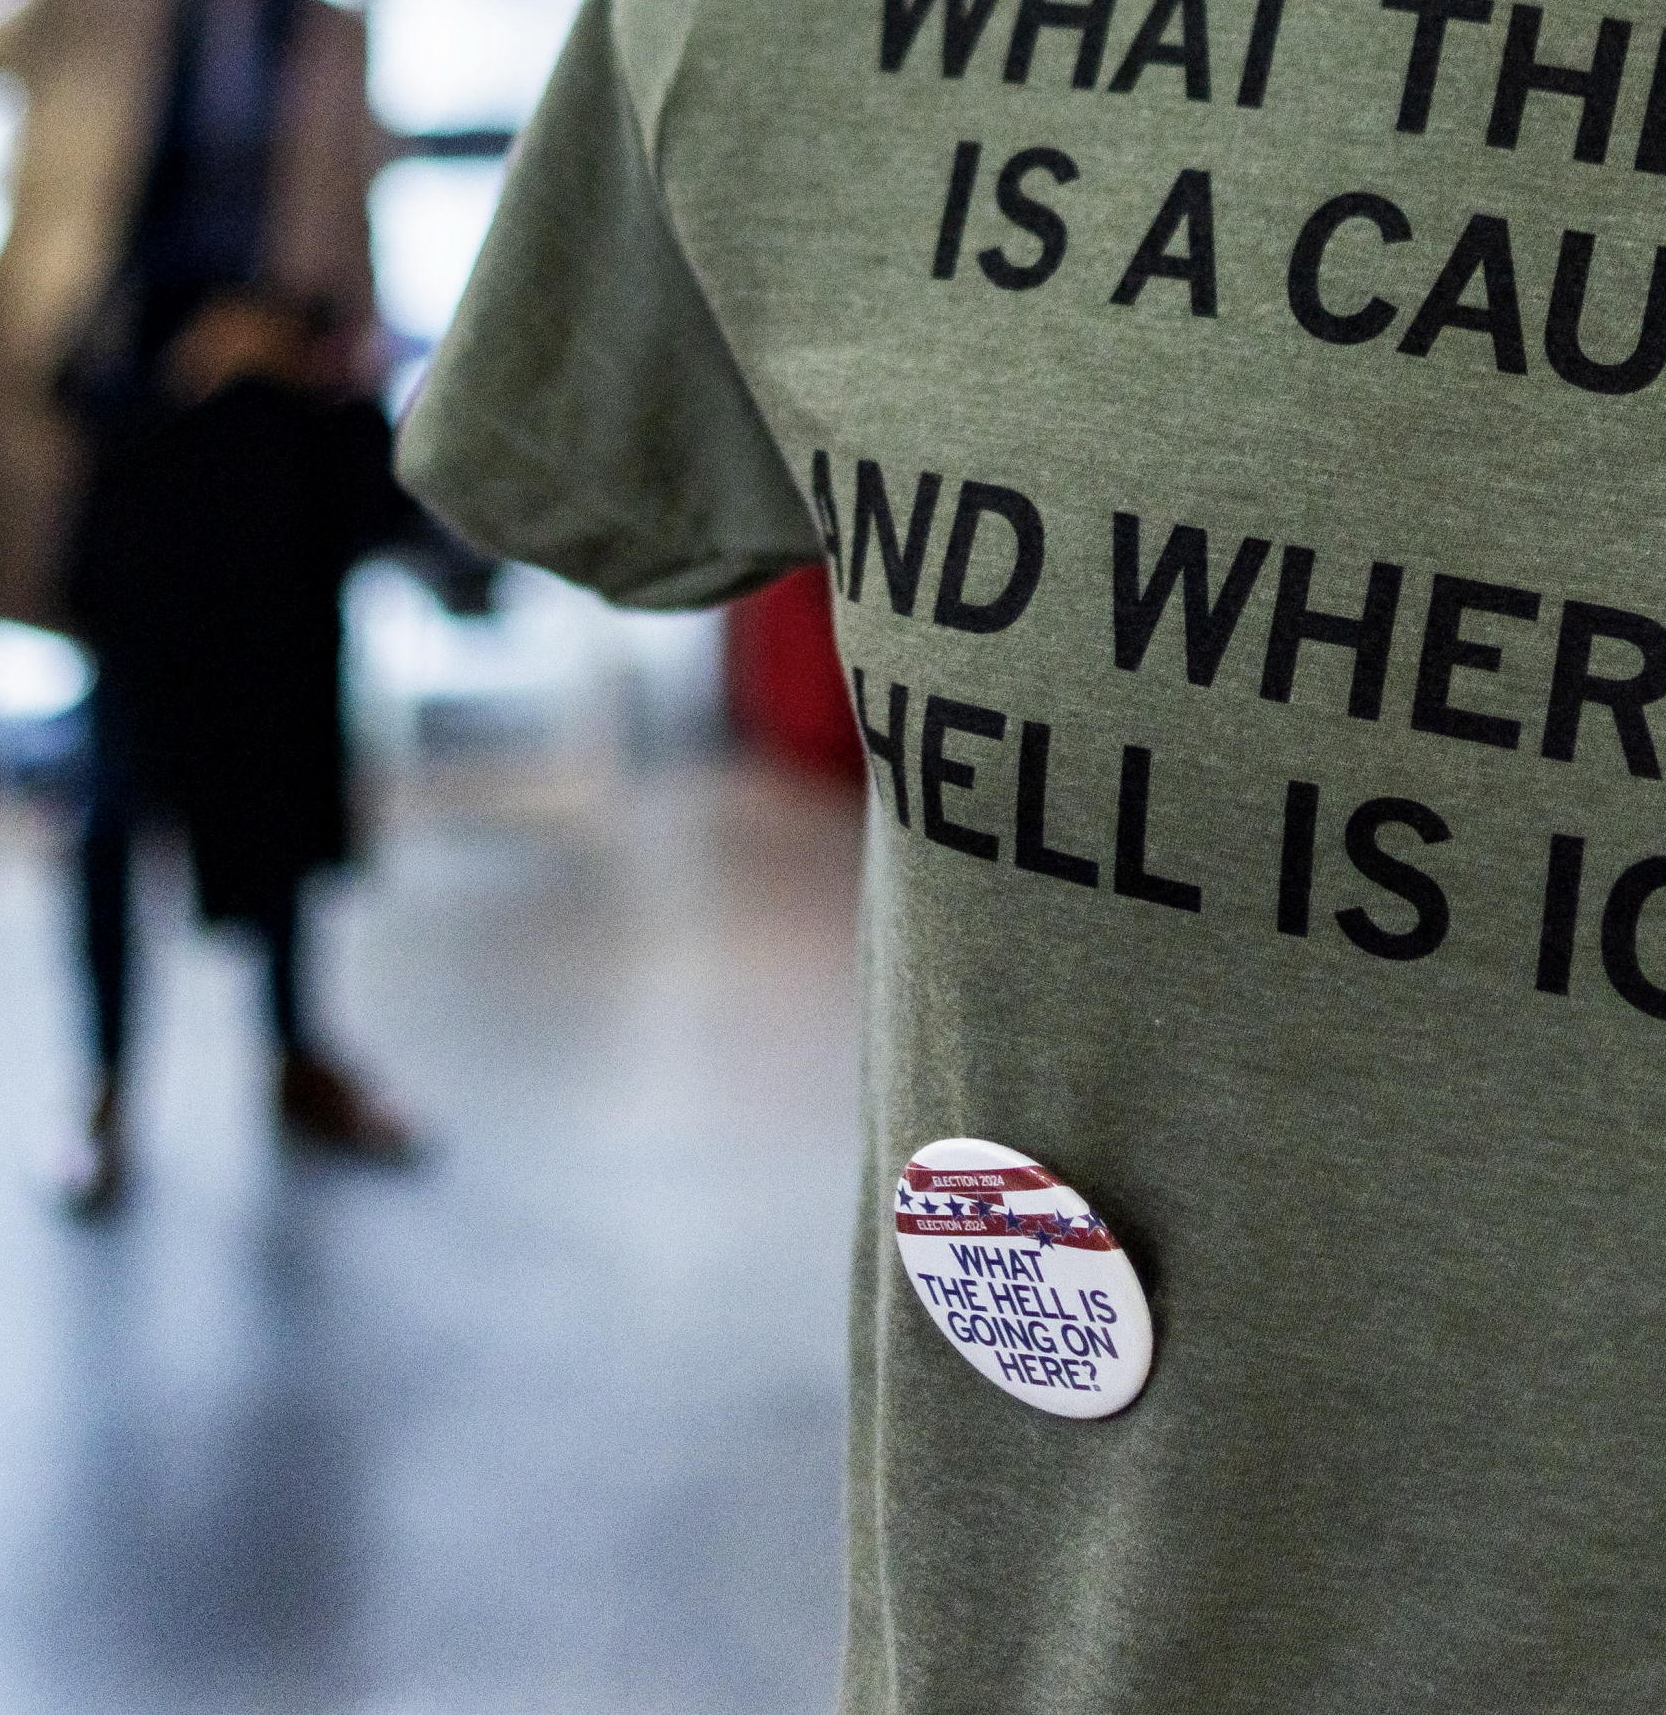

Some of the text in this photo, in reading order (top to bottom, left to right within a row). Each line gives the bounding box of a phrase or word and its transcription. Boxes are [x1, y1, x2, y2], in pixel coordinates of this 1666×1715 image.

[933, 140, 1081, 291] IS
[1109, 167, 1219, 318] A
[853, 666, 1202, 915] HELL
[1276, 779, 1454, 962] IS
[931, 1174, 1005, 1187] ELECTION 2024
[916, 1219, 987, 1233] ELECTION 2024
[948, 1242, 1042, 1283] WHAT
[916, 1272, 1118, 1325] THE HELL IS
[947, 1311, 1120, 1360] GOING ON
[994, 1350, 1101, 1392] HERE?
